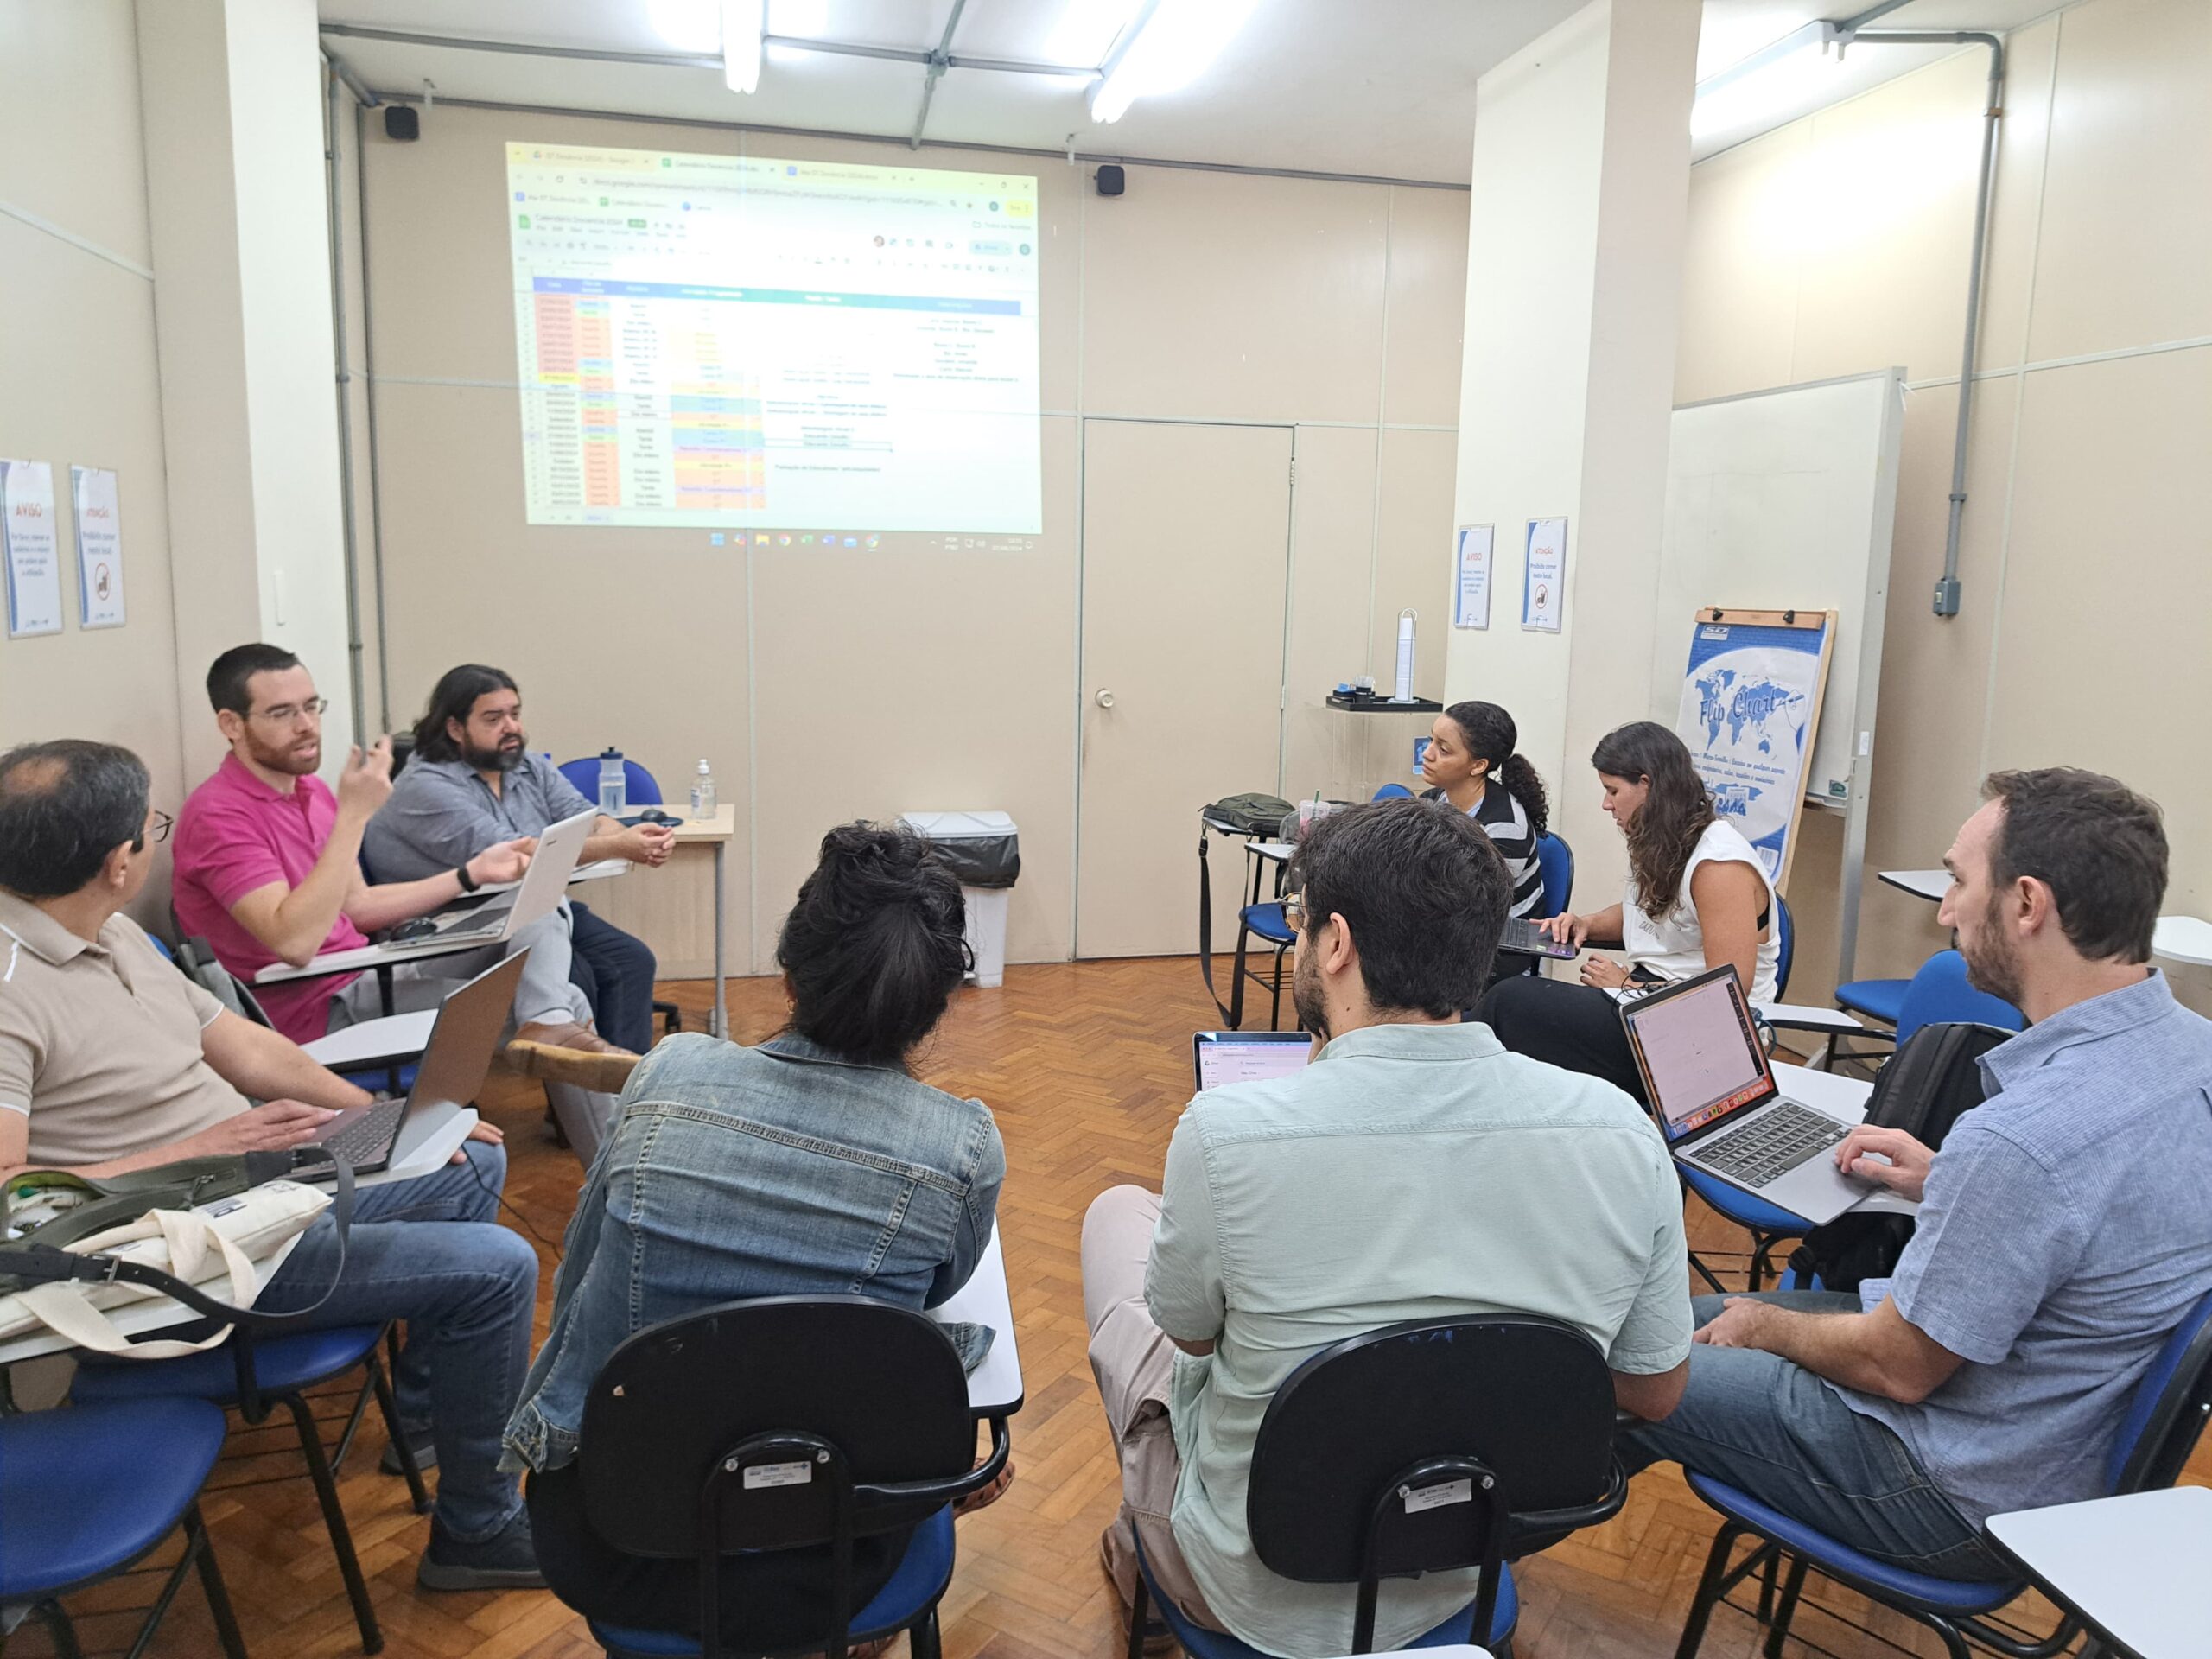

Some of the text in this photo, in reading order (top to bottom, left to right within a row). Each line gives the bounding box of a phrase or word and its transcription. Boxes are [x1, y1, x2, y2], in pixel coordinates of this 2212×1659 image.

[16, 502, 41, 518] AVISO
[1466, 552, 1483, 561] AVISO
[1704, 626, 1729, 635] SD
[1700, 689, 1776, 728] Flip Chart
